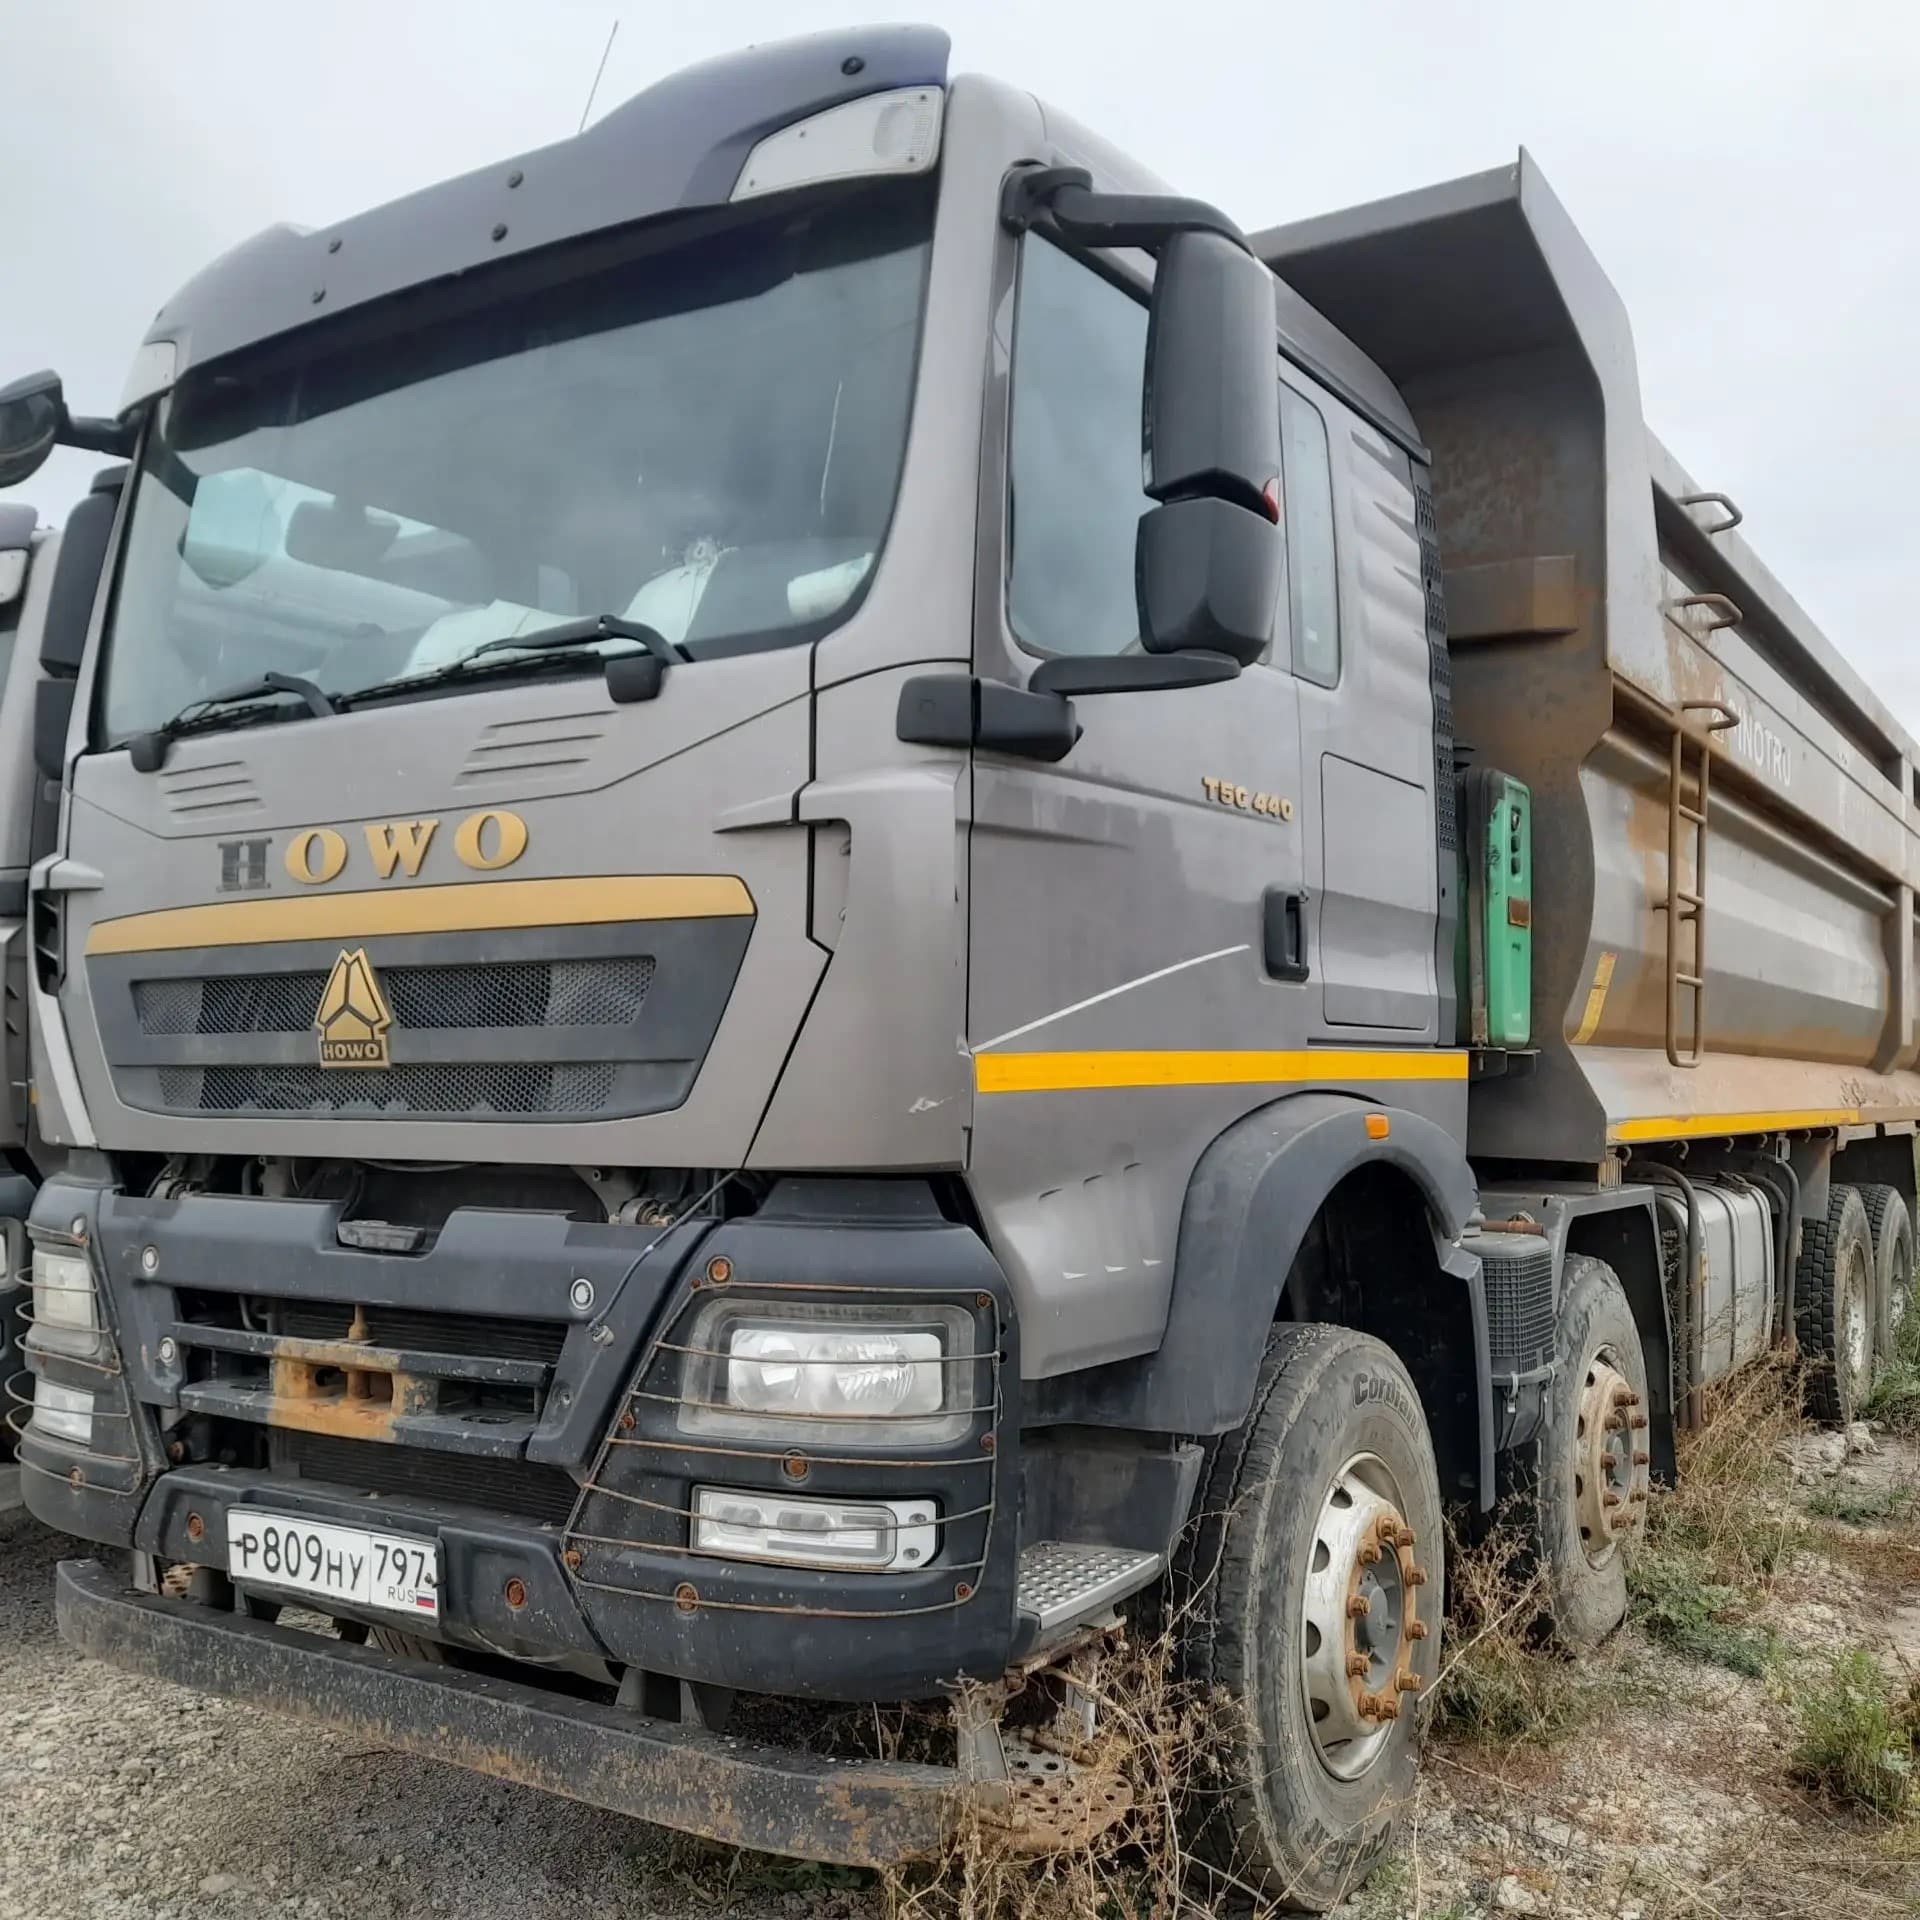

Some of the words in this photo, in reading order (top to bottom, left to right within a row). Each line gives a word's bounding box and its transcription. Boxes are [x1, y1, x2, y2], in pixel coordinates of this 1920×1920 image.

[1252, 792, 1295, 822] 440
[217, 810, 529, 893] HOWO
[323, 1042, 380, 1060] HOWO
[374, 1543, 426, 1589] 797
[387, 1585, 416, 1604] RUS
